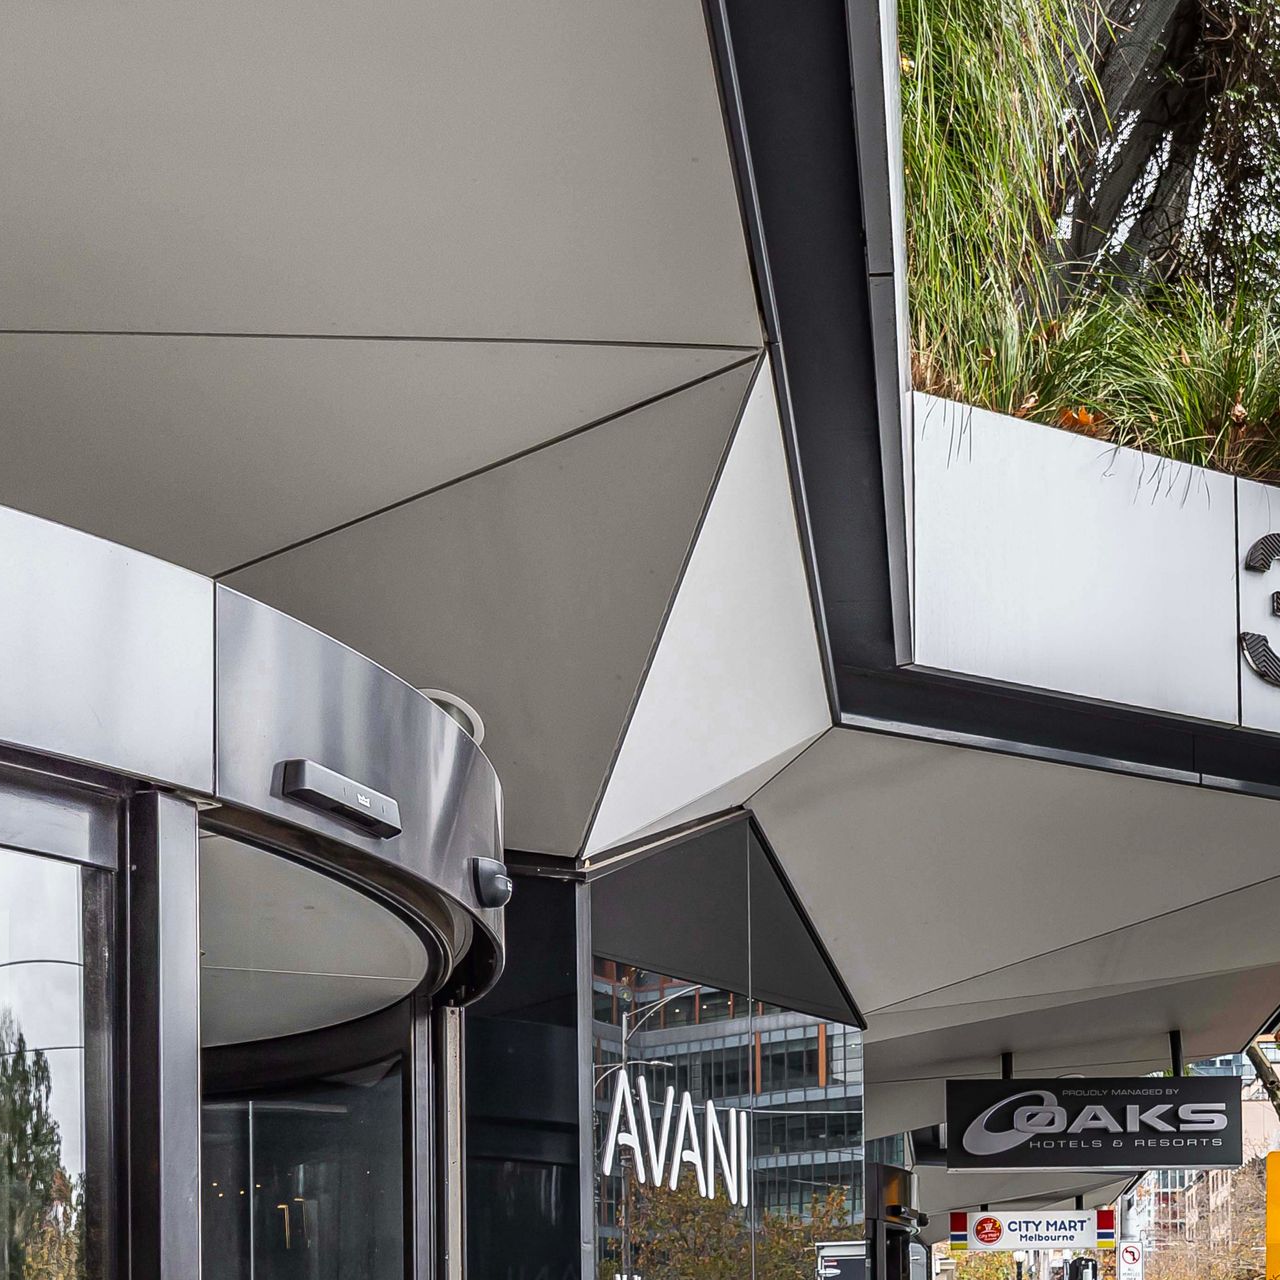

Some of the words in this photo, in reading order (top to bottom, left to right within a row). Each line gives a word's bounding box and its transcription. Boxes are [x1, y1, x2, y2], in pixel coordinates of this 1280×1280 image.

[1062, 1089, 1107, 1097] PROUDLY
[1111, 1088, 1162, 1096] MANAGED
[1014, 1103, 1228, 1134] OAKS
[602, 1068, 750, 1207] AVANI
[1029, 1140, 1103, 1149] HOTELS
[1112, 1140, 1123, 1148] &
[1135, 1138, 1223, 1147] RESORTS
[1007, 1220, 1042, 1232] CITY
[1046, 1219, 1087, 1232] MART
[1020, 1233, 1075, 1242] Melbourne
